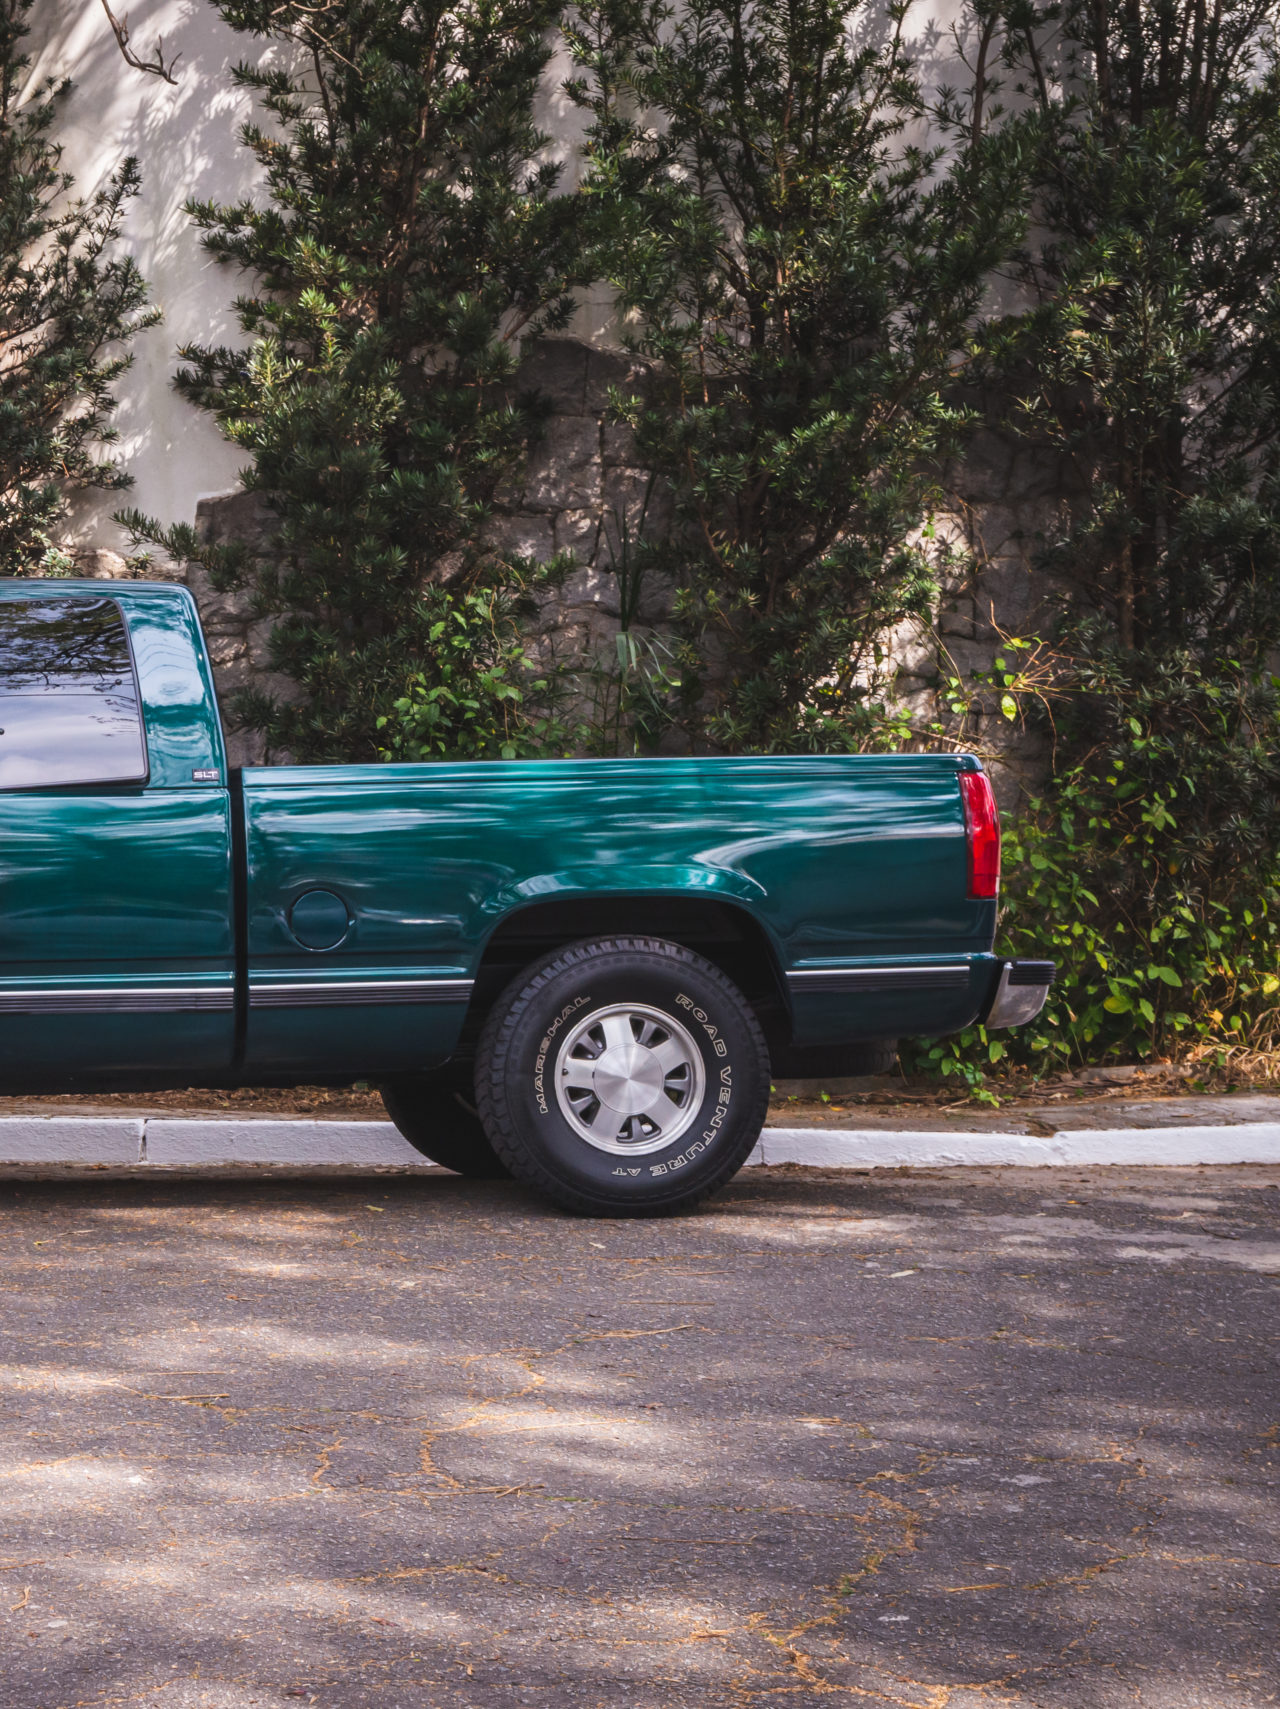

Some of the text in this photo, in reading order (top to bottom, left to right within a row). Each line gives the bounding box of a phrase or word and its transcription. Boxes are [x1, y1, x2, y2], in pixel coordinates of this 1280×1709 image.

[194, 771, 218, 779] SLT
[534, 996, 591, 1114] MARSHAL
[611, 993, 732, 1177] ROAD VENTURE AT
